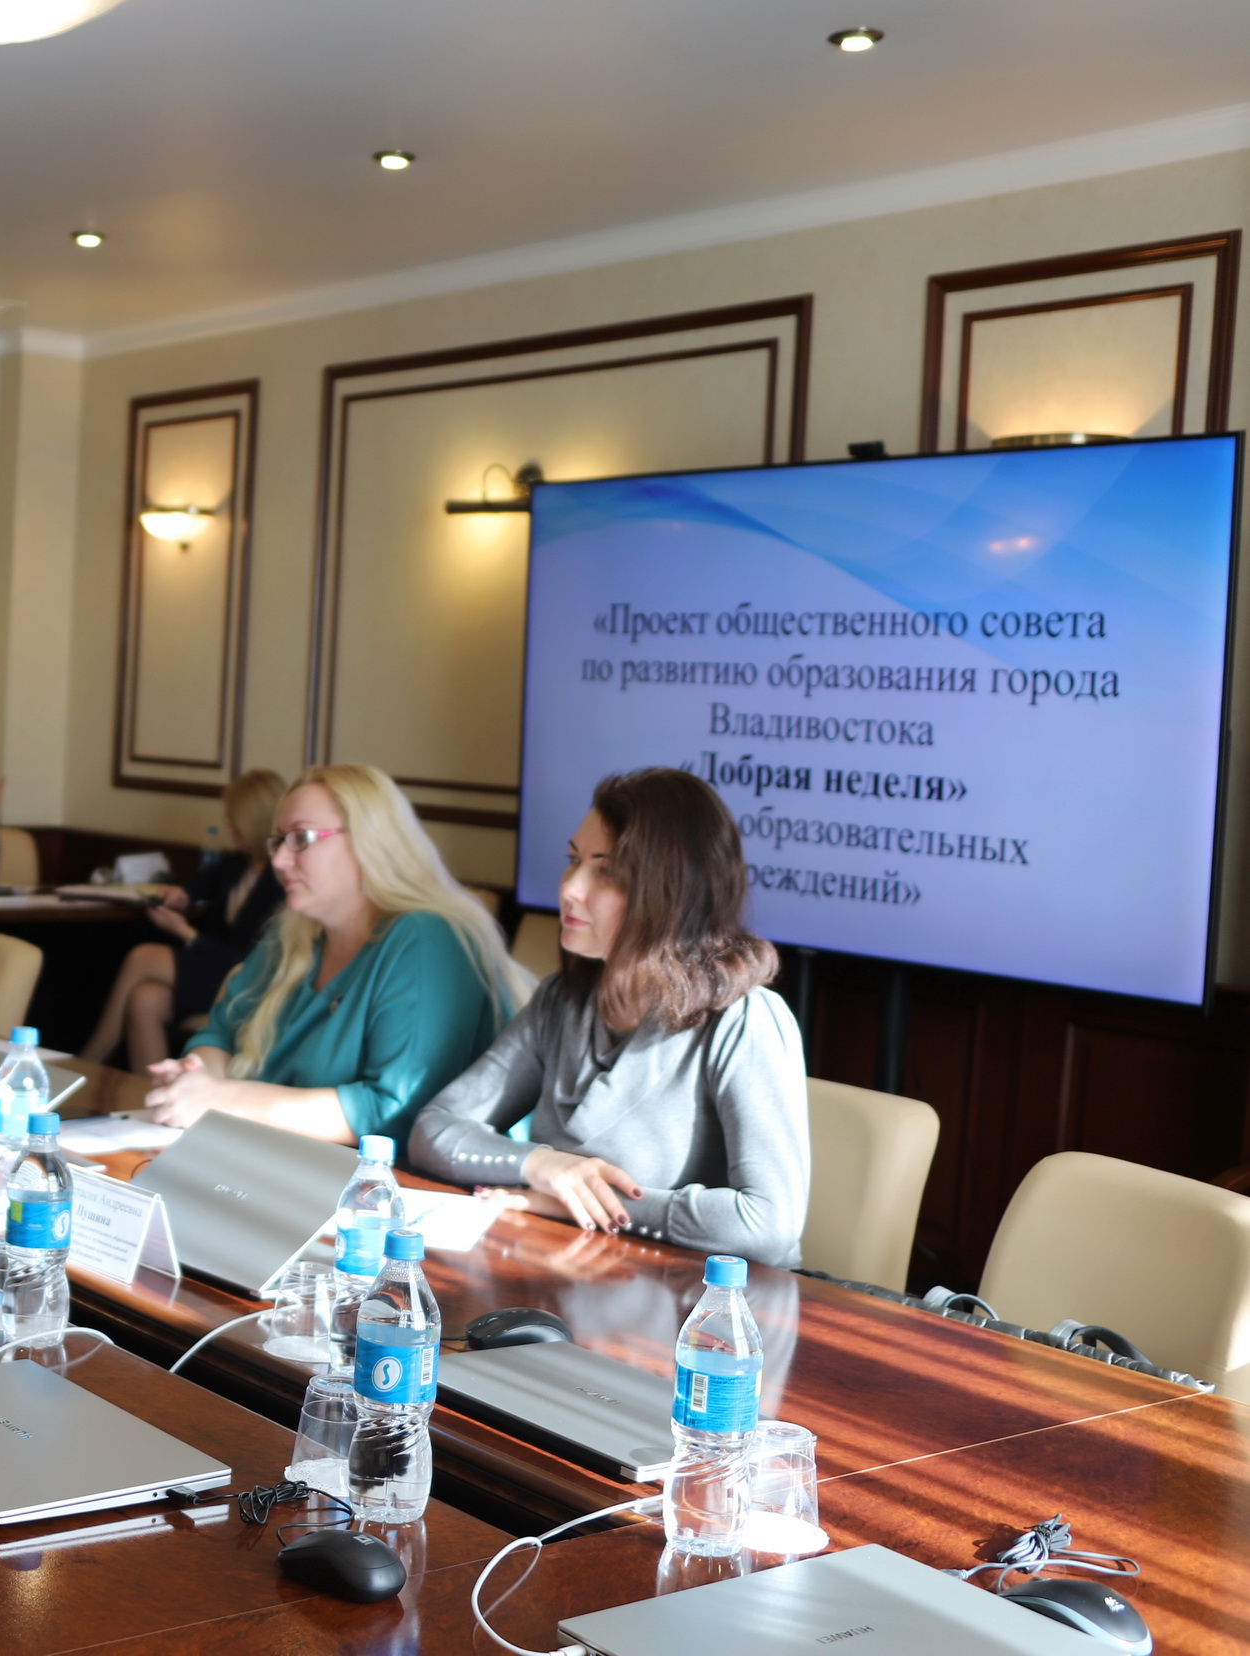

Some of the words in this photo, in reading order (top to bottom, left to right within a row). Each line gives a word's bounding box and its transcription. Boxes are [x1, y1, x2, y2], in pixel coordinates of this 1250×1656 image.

[593, 603, 710, 644] «Проект
[716, 602, 968, 639] общественного
[980, 611, 1107, 638] совета
[581, 658, 614, 681] по
[620, 659, 758, 691] развитию
[767, 653, 976, 698] образования
[990, 667, 1120, 706] города
[709, 702, 934, 746] Владивостока
[824, 767, 967, 801] неделя»
[738, 806, 1030, 865] образовательных
[745, 862, 922, 906] реждений»
[815, 1625, 876, 1645] HUAWEI
